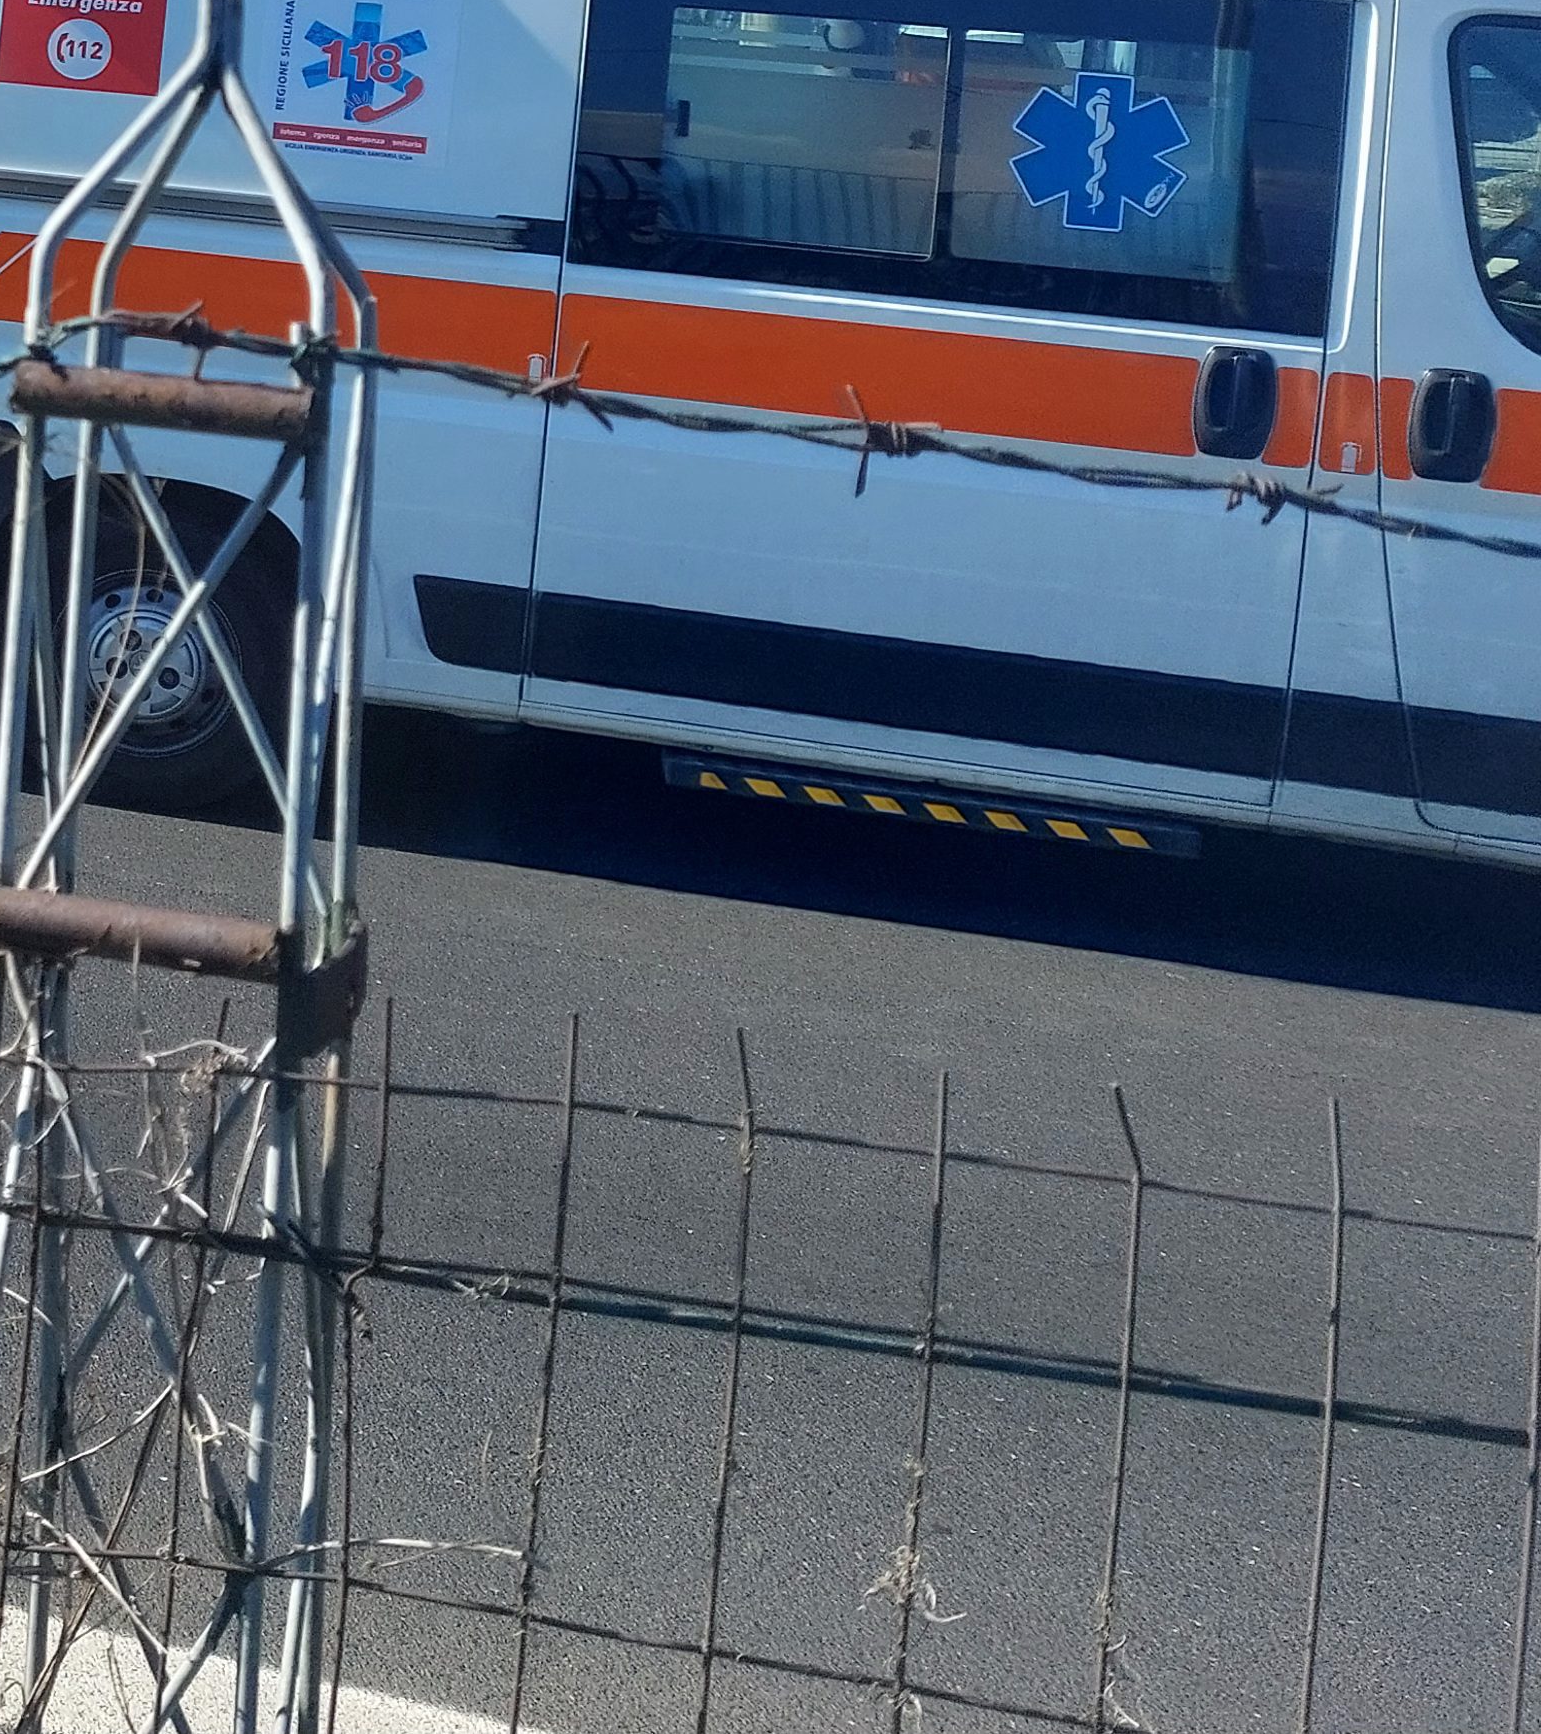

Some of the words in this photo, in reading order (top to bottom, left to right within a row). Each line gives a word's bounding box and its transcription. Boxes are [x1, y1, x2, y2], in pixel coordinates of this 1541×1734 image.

[66, 40, 103, 60] 112
[281, 0, 295, 58] SICILIANA
[276, 60, 289, 111] REGIONE
[320, 40, 403, 84] 118
